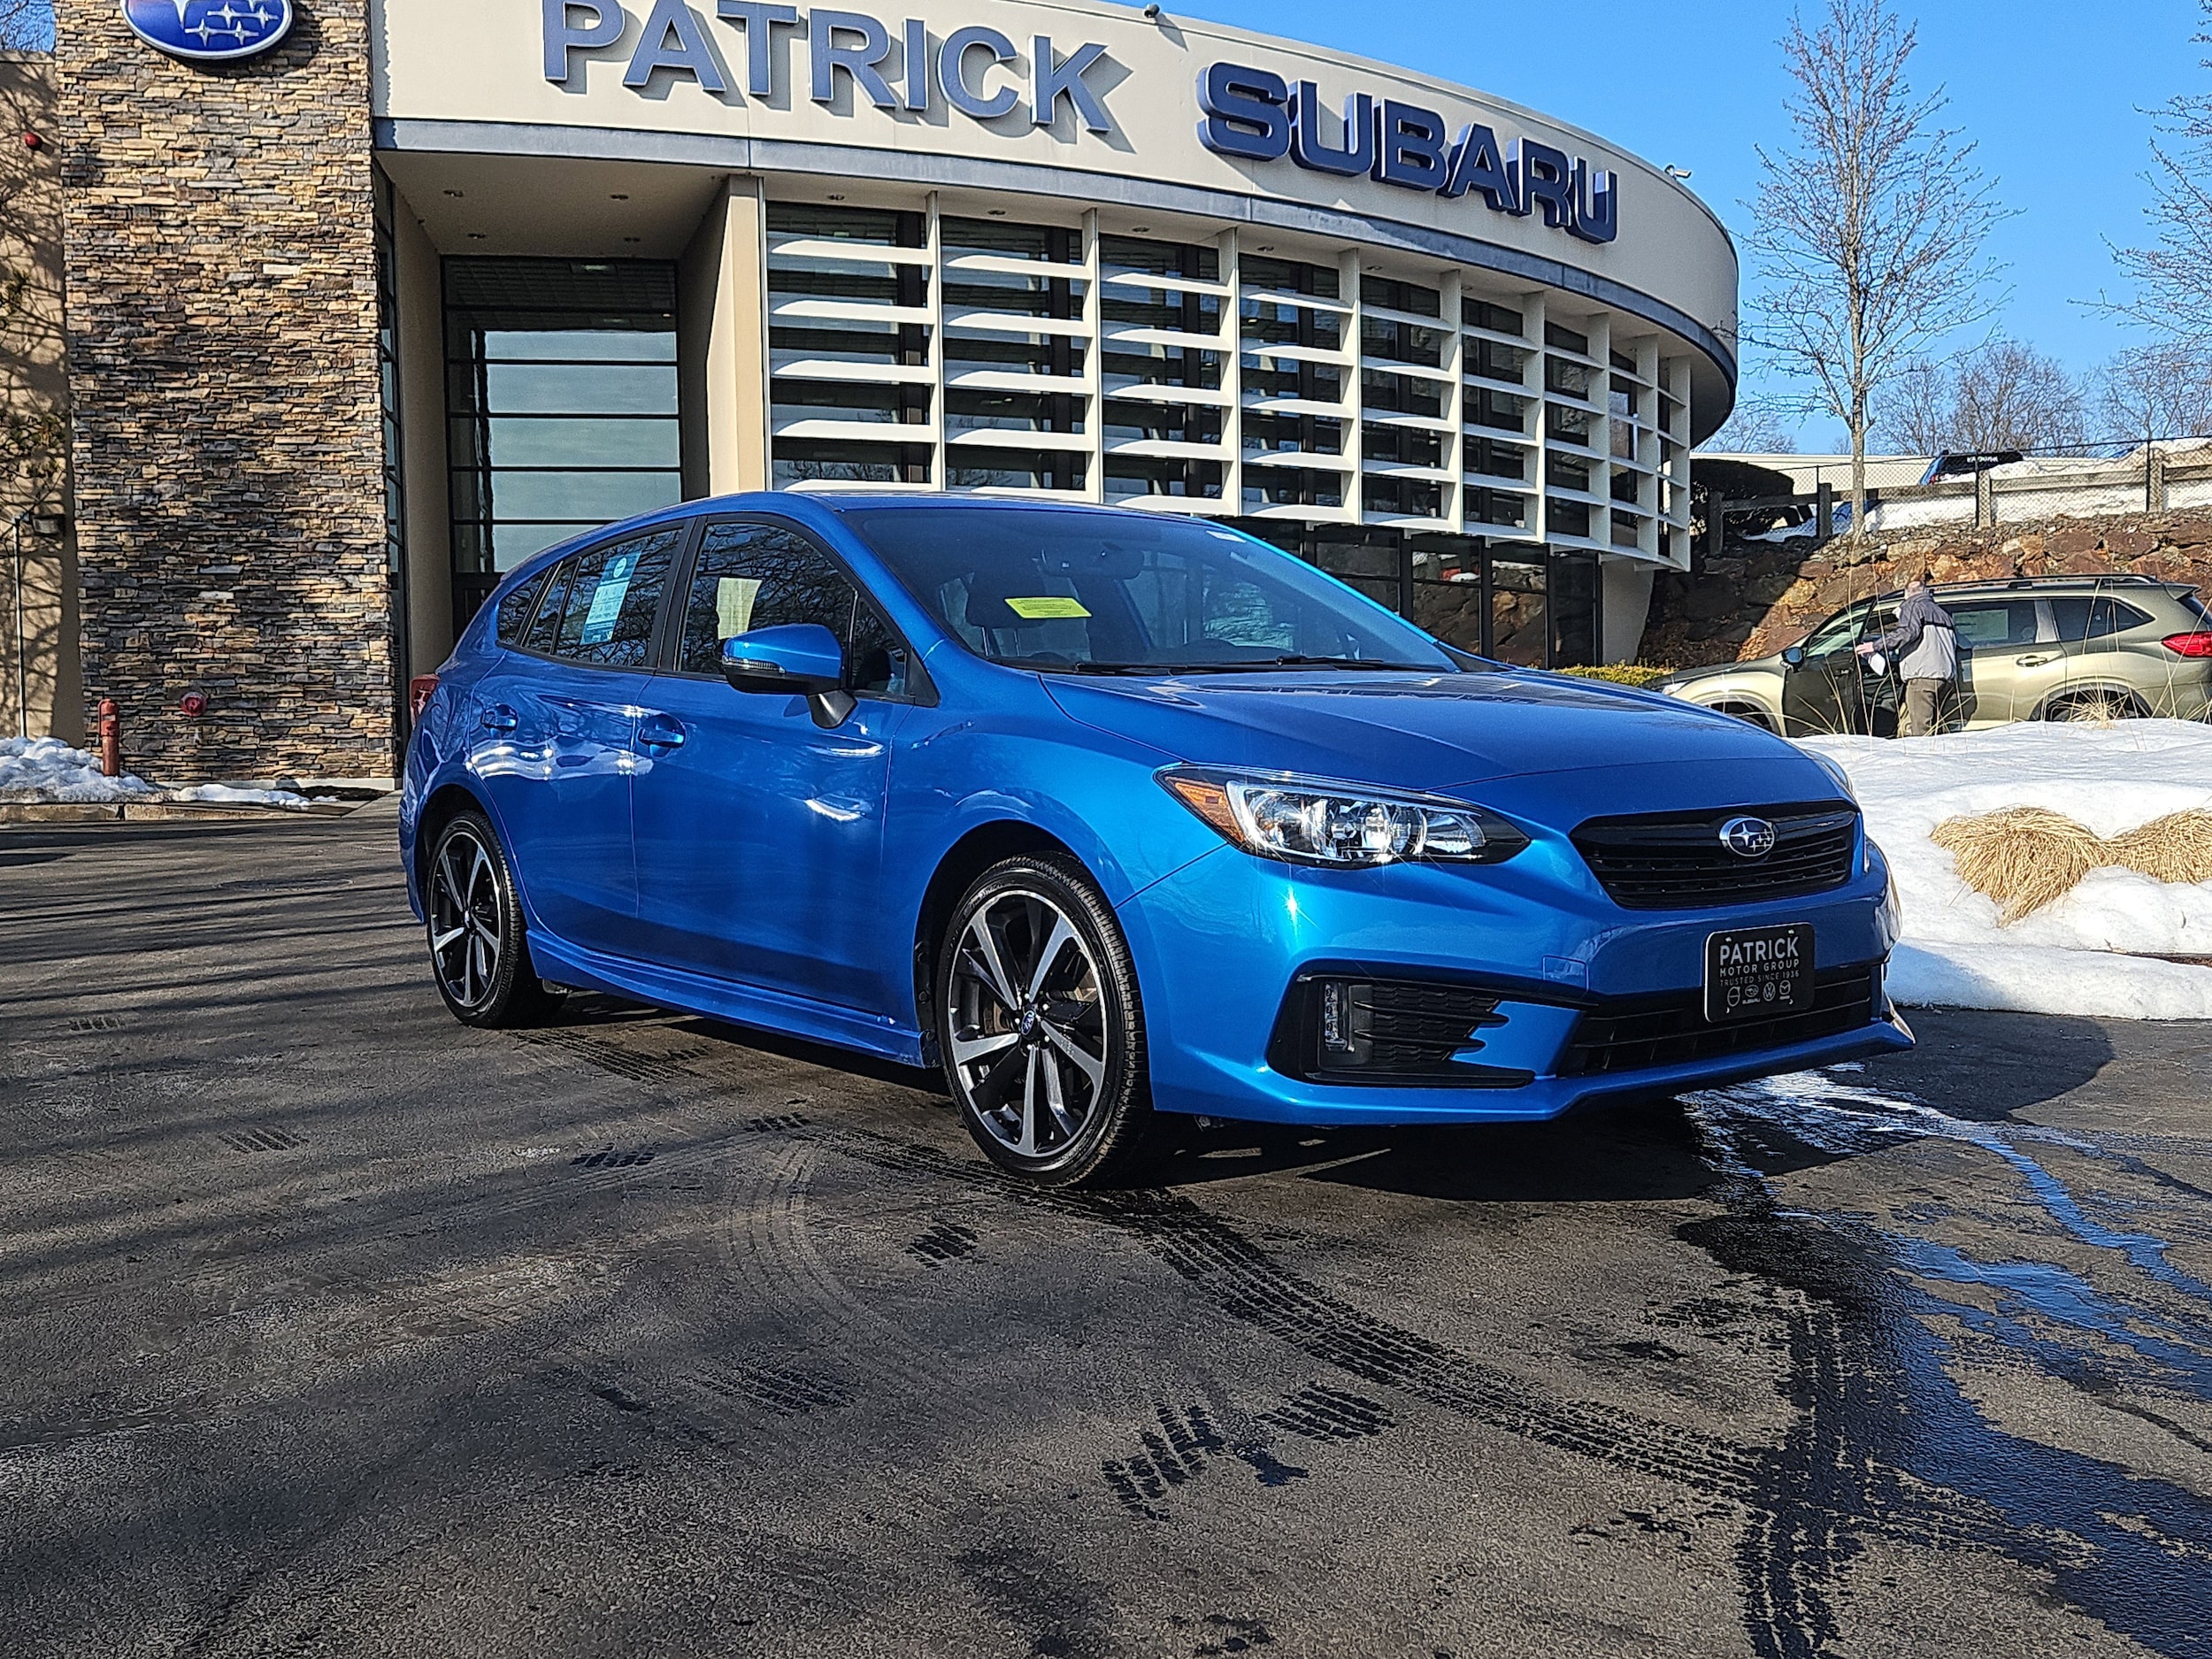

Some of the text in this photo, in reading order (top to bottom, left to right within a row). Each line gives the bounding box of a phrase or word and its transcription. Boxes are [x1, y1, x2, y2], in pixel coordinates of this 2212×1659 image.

[543, 0, 1111, 132] PATRICK
[1196, 61, 1617, 244] SUBARU
[1719, 936, 1799, 965] PATRICK
[1719, 958, 1800, 978] MOTOR GROUP
[1720, 970, 1800, 987] TRUSTED SINCE 1936
